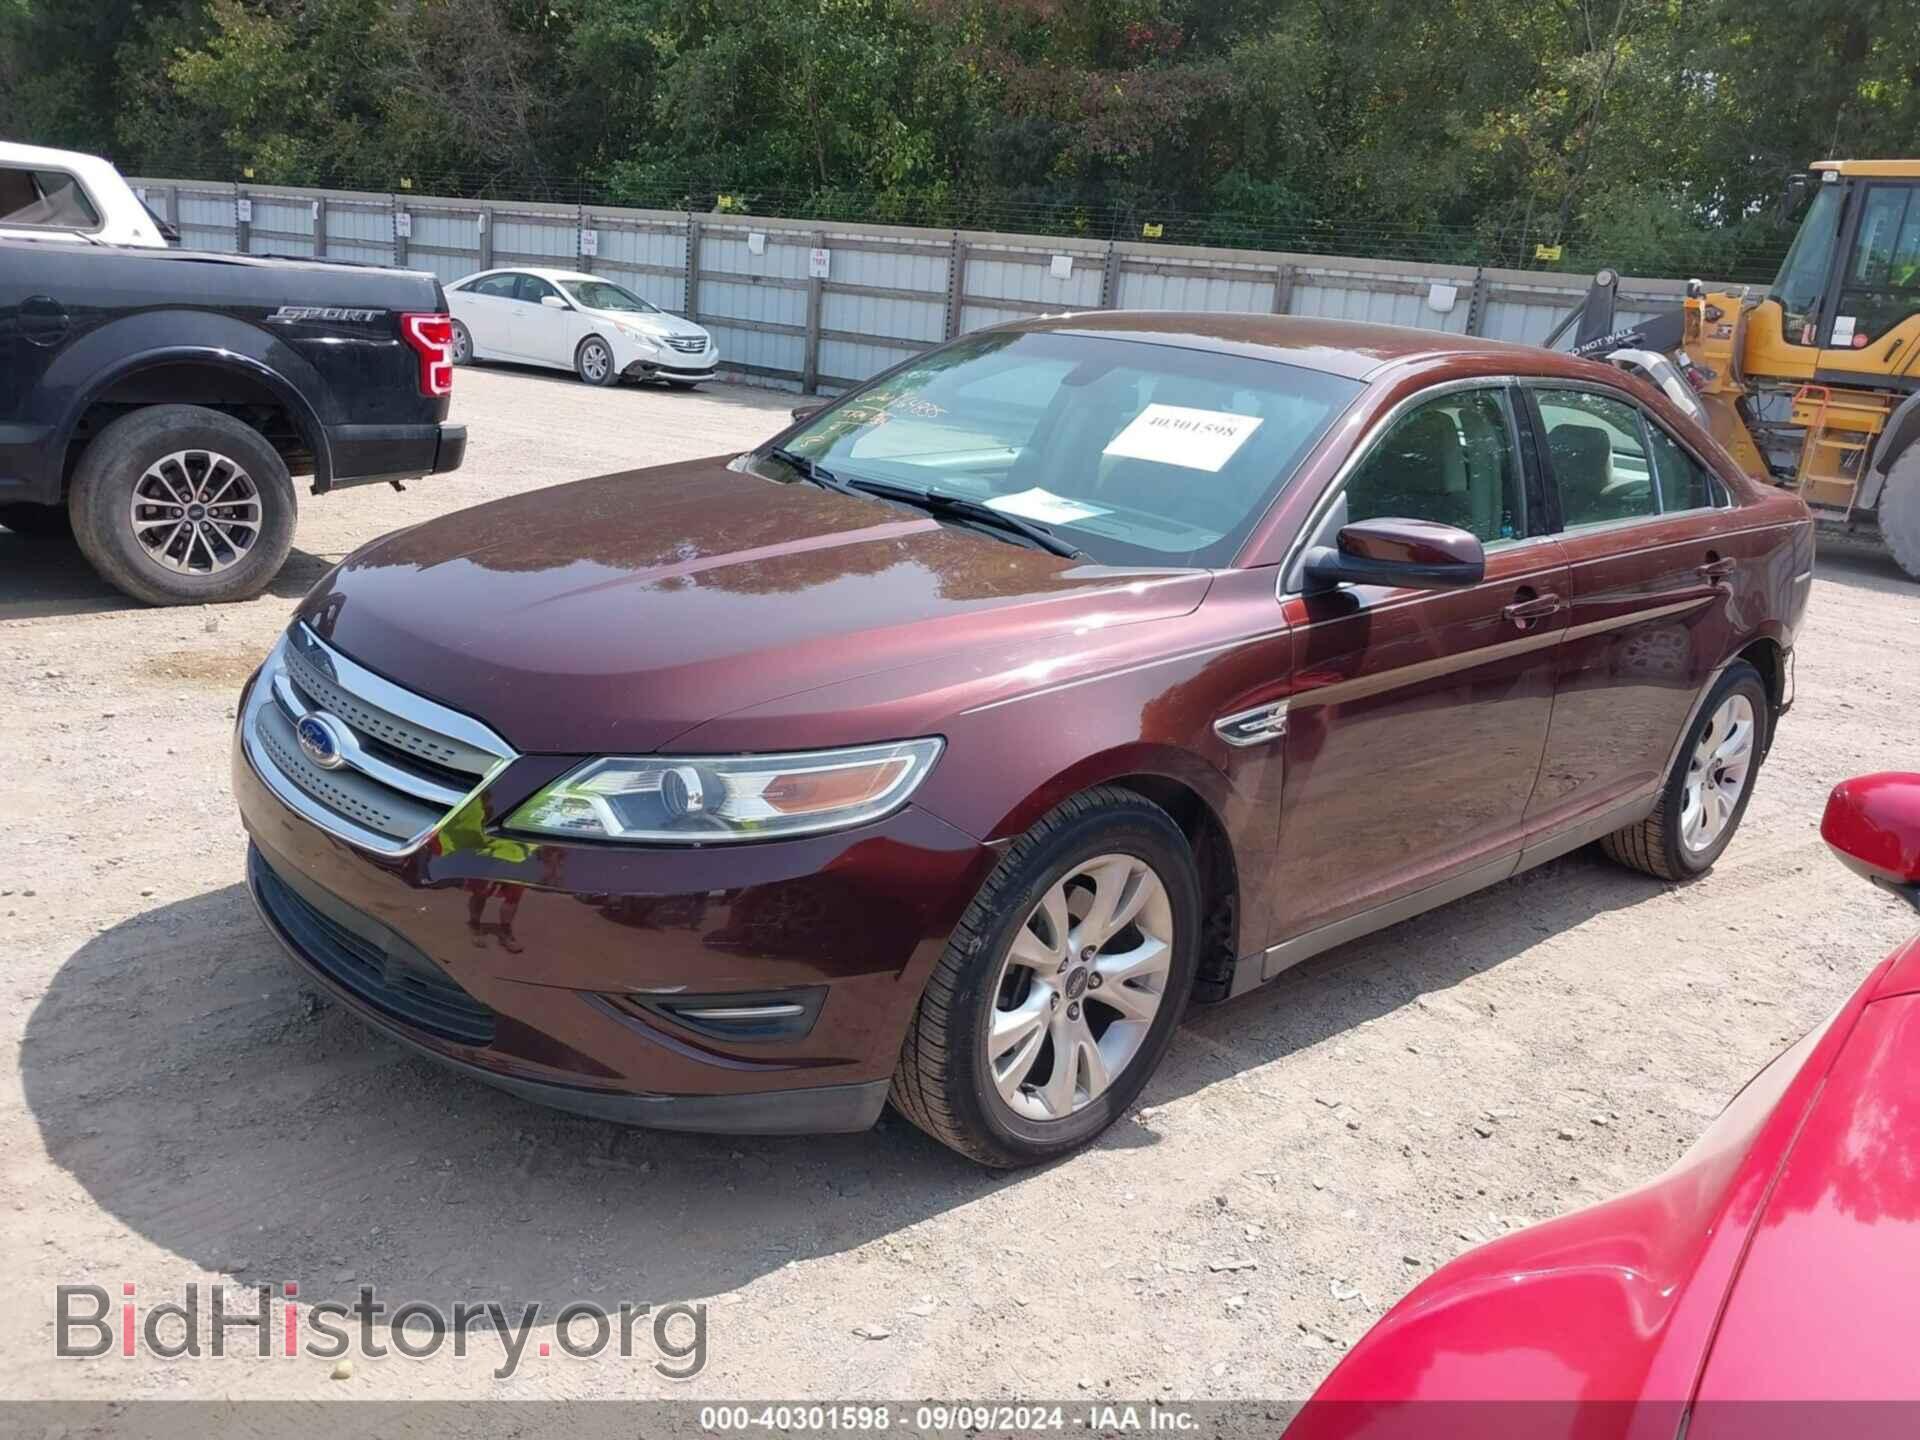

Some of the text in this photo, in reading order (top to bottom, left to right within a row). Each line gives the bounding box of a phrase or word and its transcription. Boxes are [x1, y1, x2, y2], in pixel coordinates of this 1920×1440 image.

[267, 306, 386, 321] SPORT
[1582, 337, 1604, 353] NOT
[1604, 328, 1634, 345] WALK
[1148, 416, 1238, 437] 40301598
